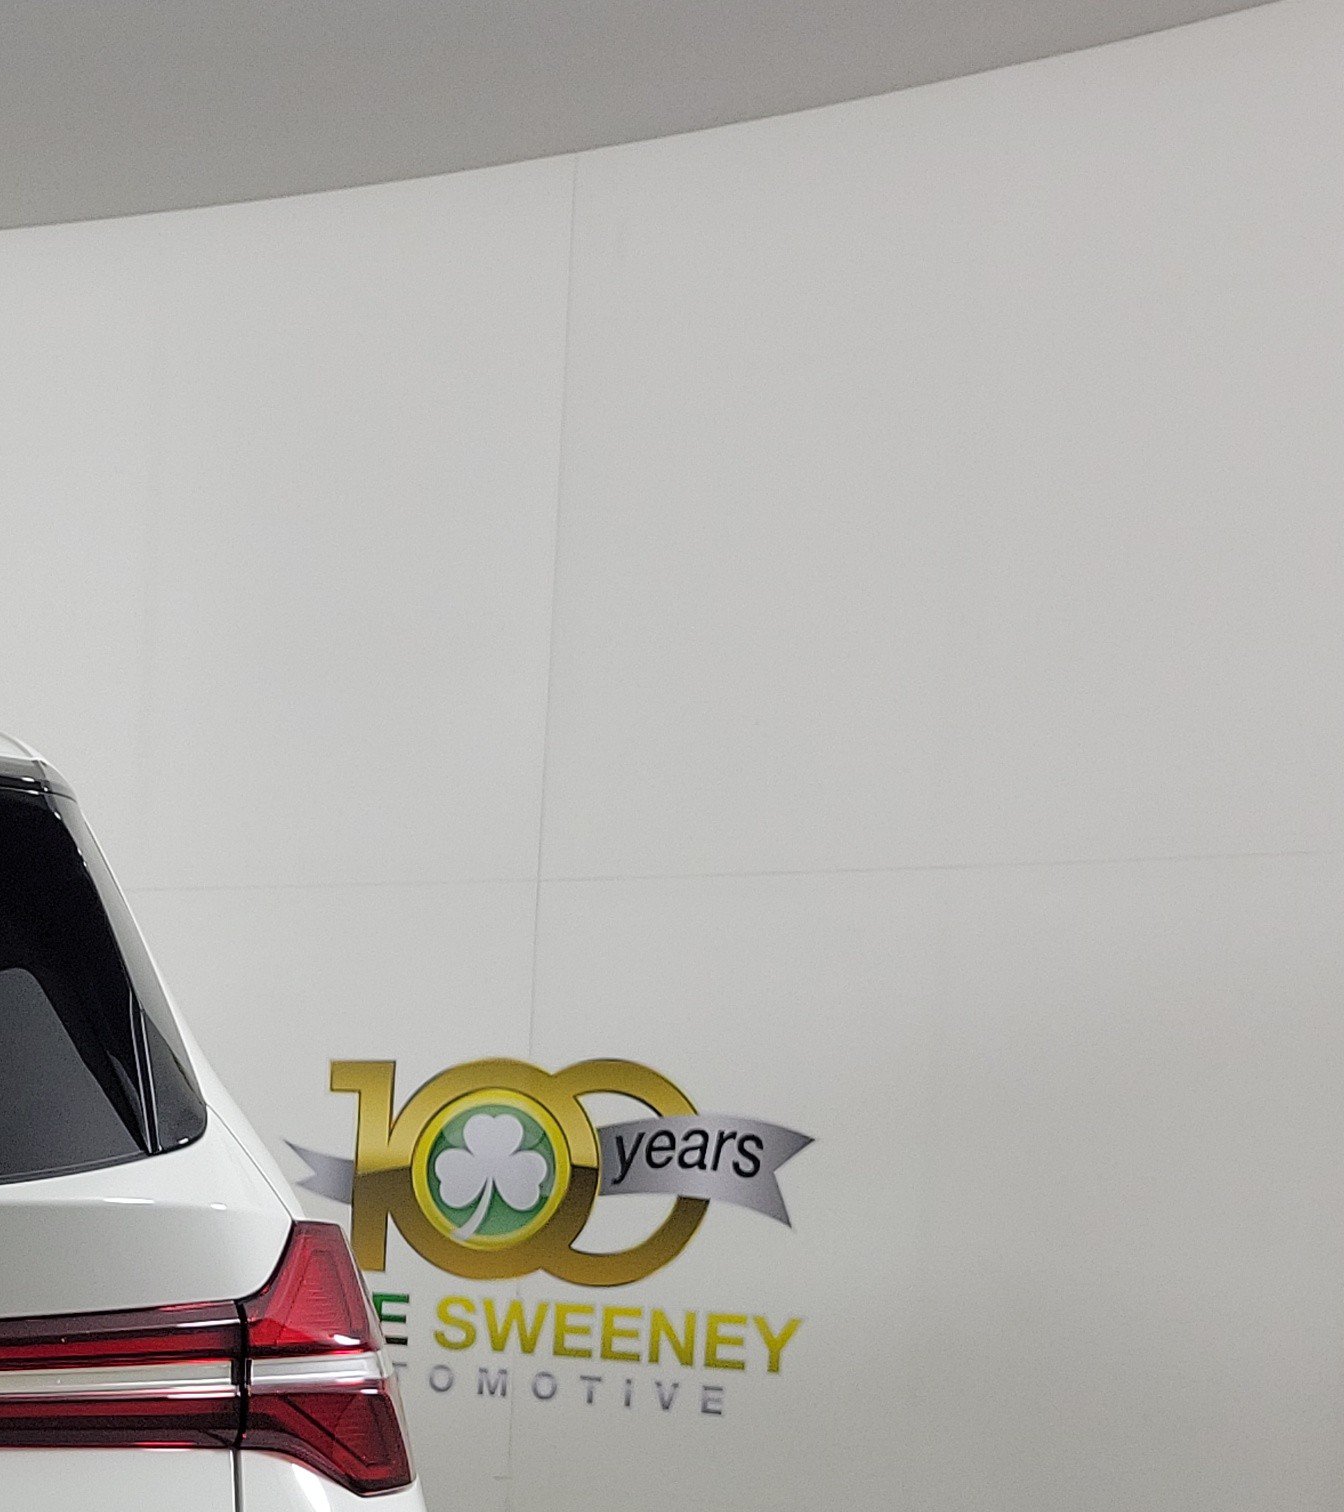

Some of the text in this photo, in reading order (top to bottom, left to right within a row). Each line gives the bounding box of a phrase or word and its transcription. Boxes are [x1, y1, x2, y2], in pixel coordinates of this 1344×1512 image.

[329, 1058, 712, 1288] 100
[612, 1129, 764, 1185] years
[433, 1296, 801, 1374] SWEENEY
